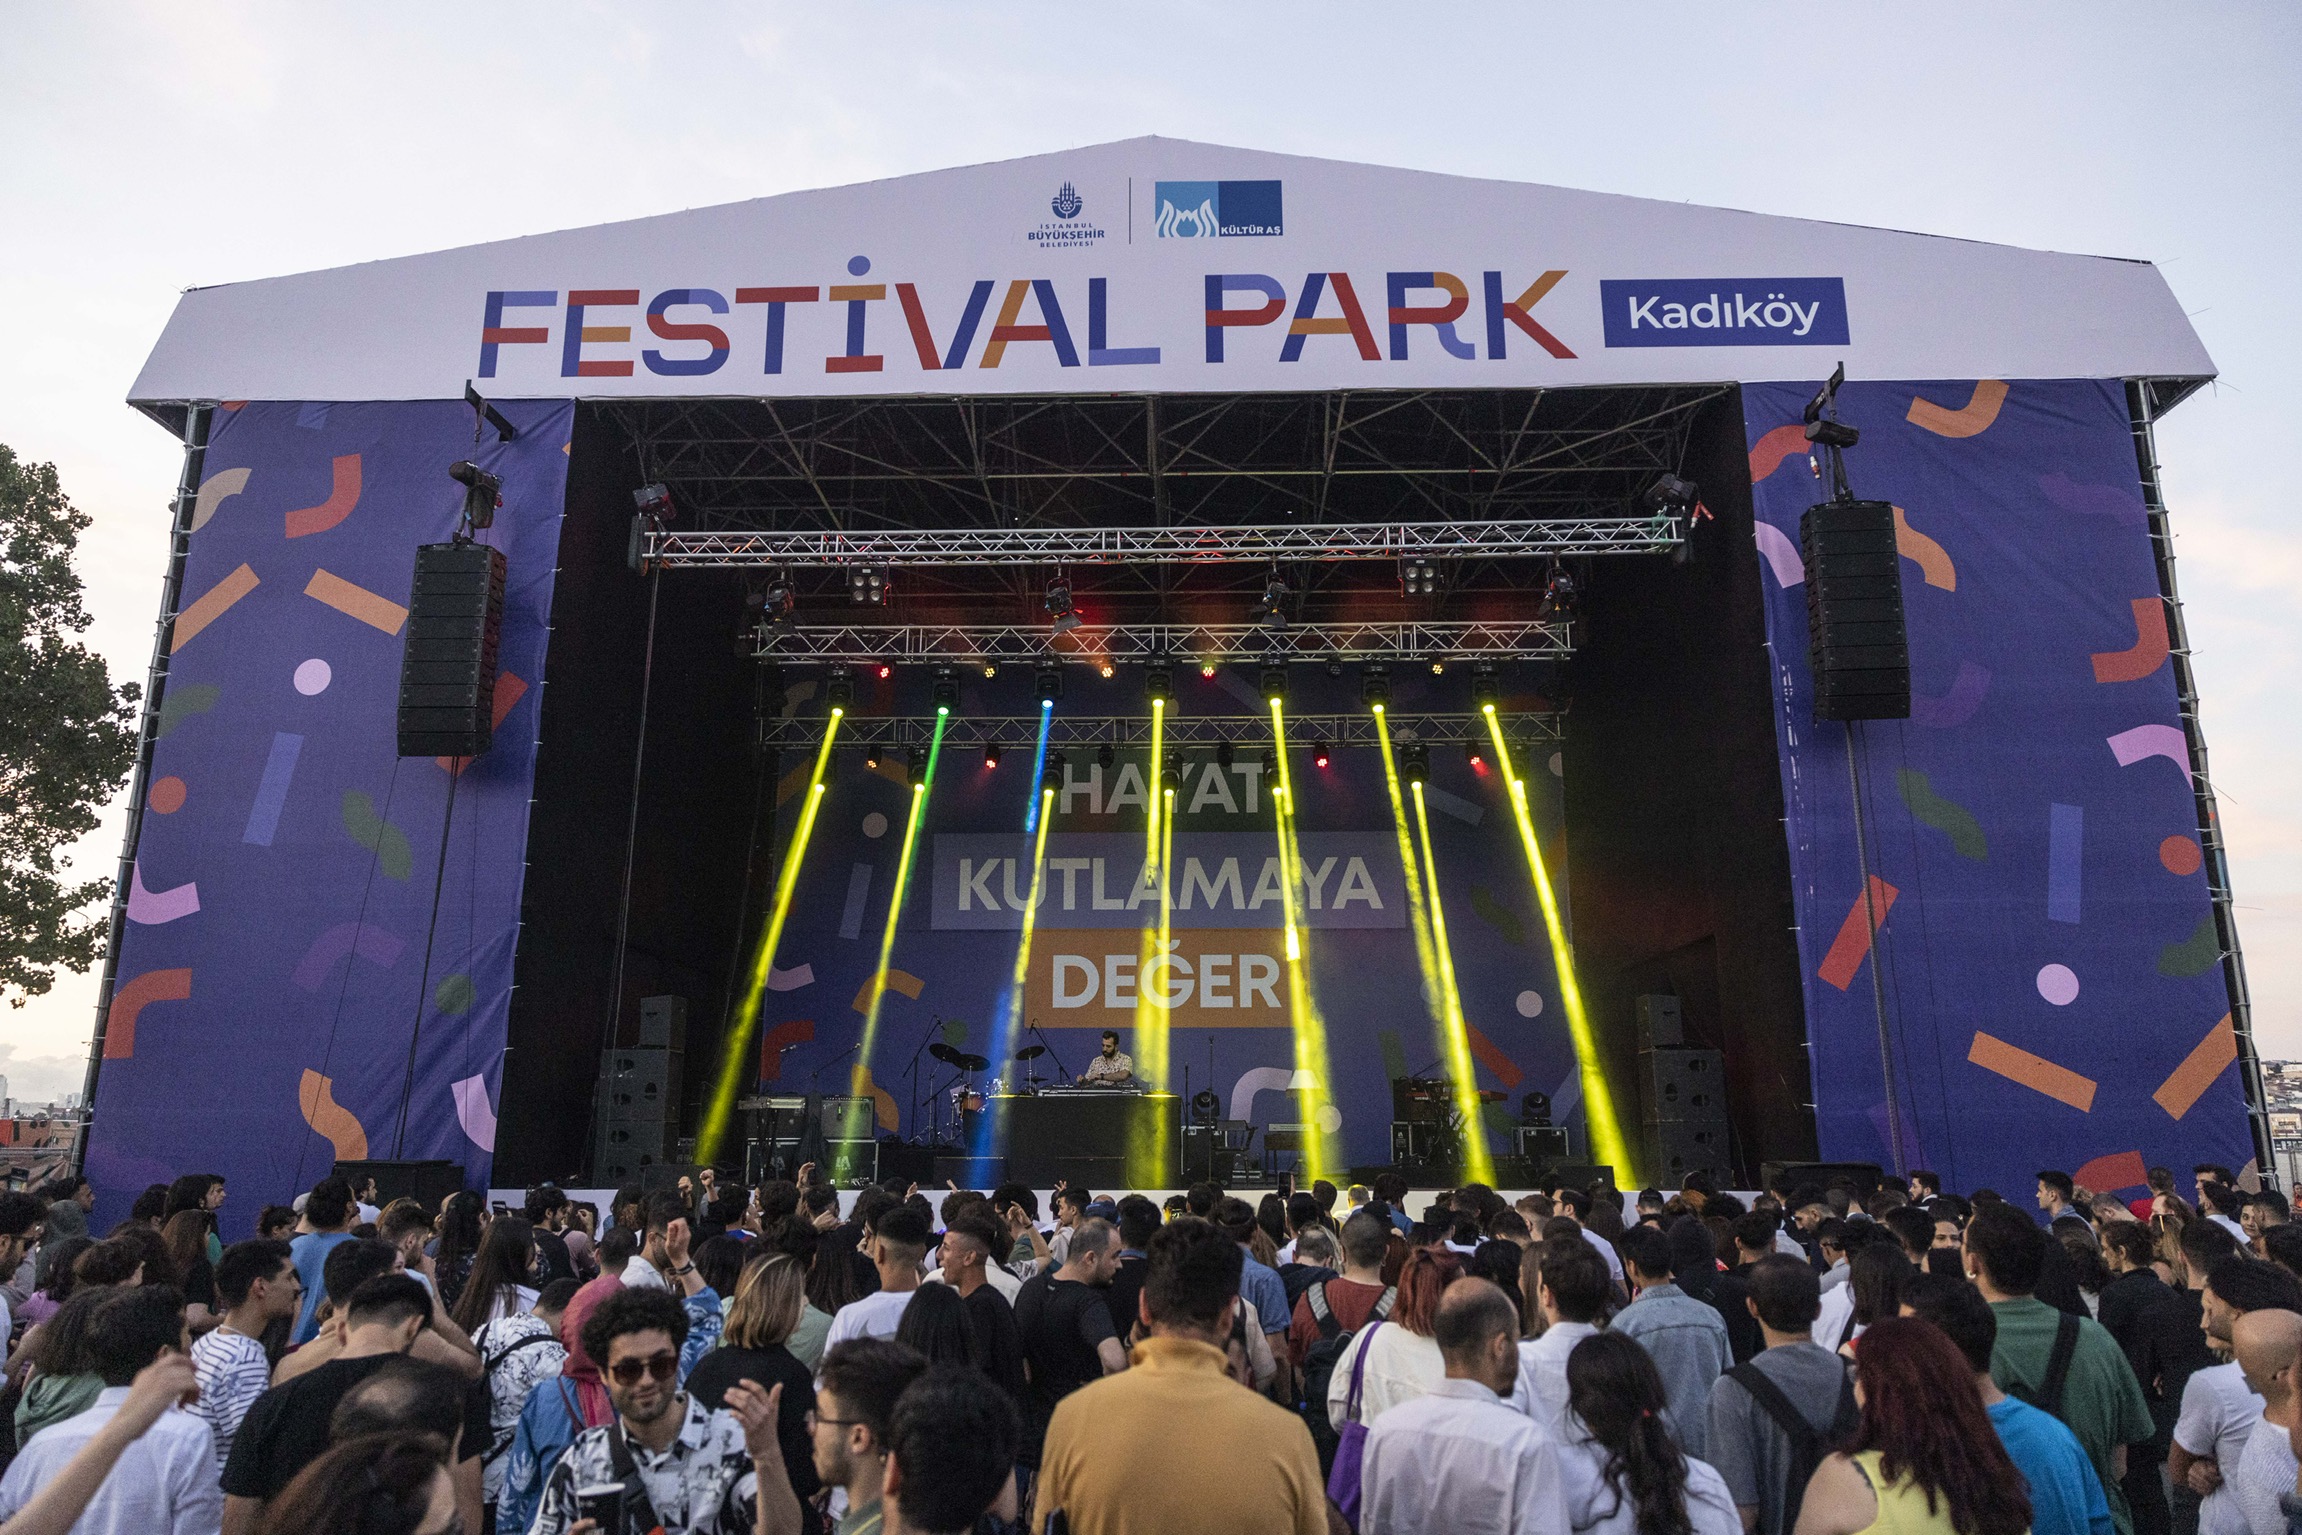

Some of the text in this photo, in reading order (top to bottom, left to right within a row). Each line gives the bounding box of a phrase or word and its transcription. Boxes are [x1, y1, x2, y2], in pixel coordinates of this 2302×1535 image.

[1028, 229, 1105, 240] BÜYÜKŞEHİR
[1040, 222, 1093, 230] İSTANBUL
[1221, 224, 1281, 235] KÜLTÜR AŞ
[1040, 240, 1093, 248] BELEDİYESİ
[477, 255, 1579, 378] FESTİVAL PARK
[1629, 293, 1820, 336] Kadıköy
[958, 856, 1384, 911] KUTLAMAYA
[1052, 939, 1283, 1009] DEĞER
